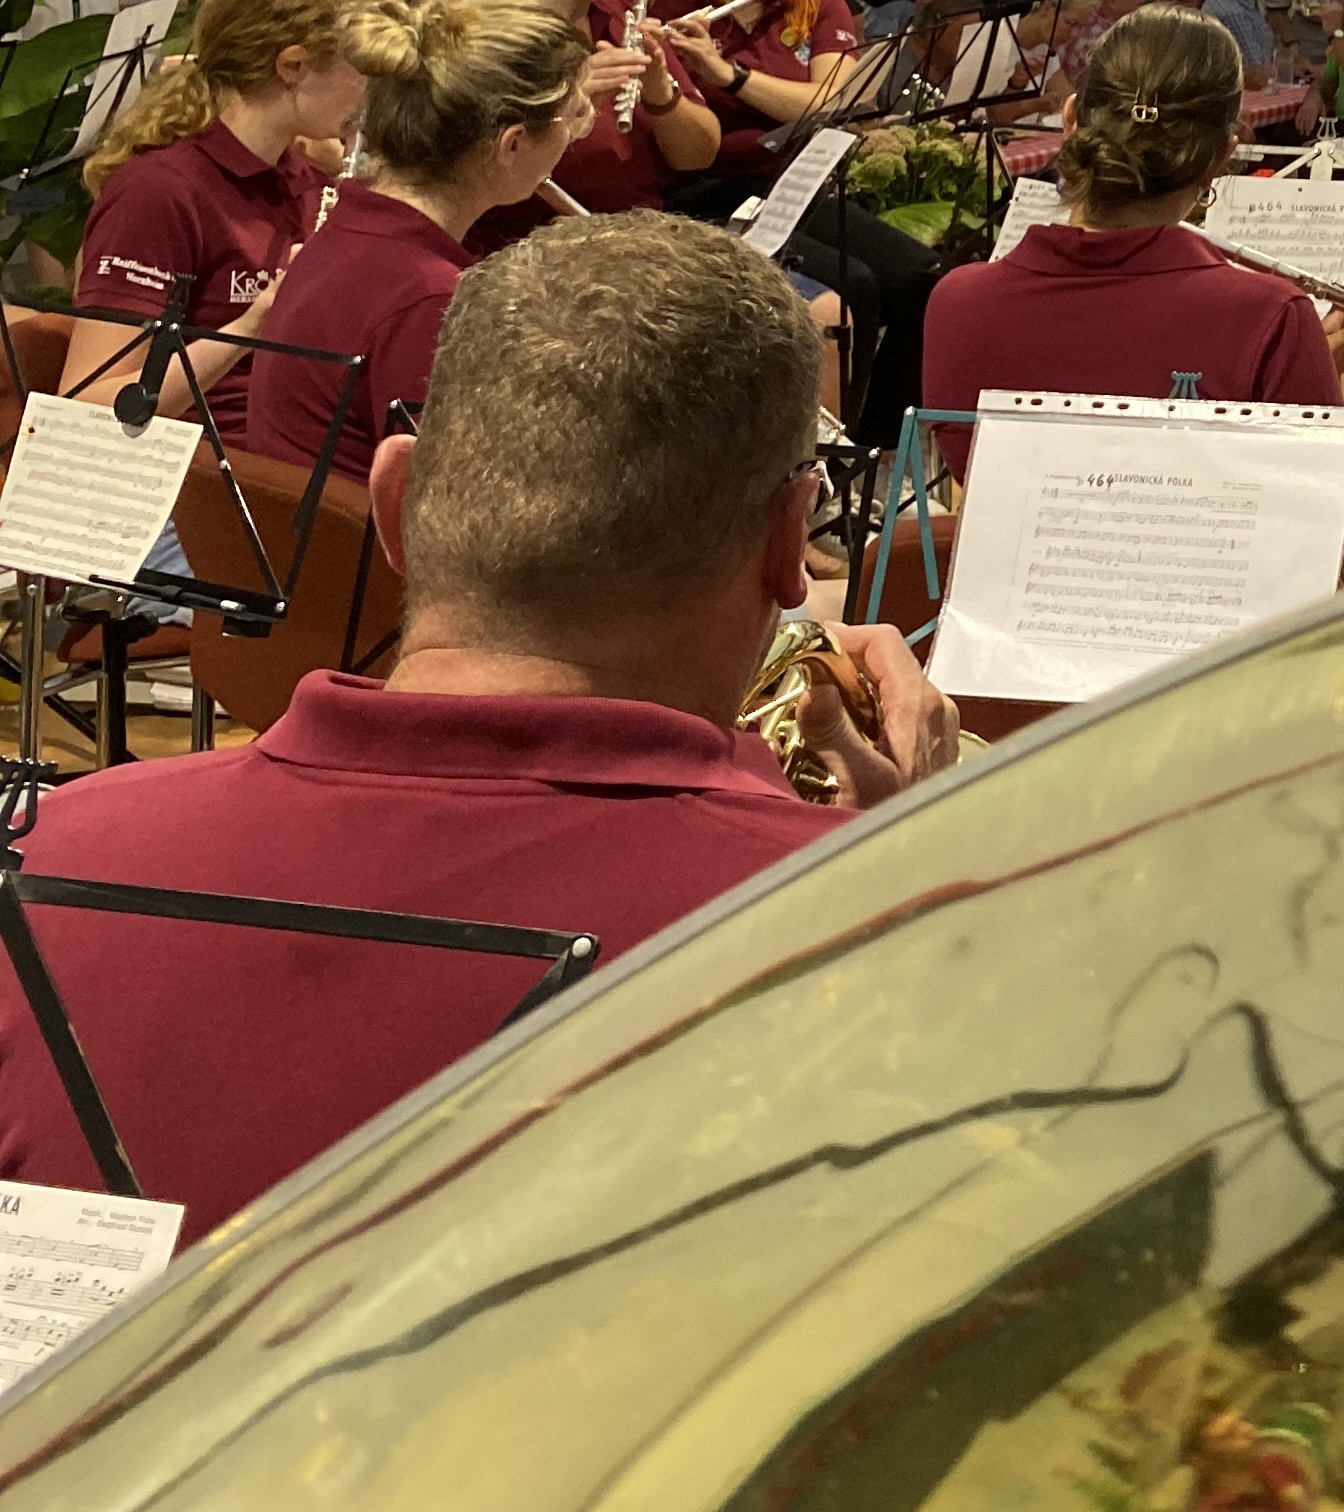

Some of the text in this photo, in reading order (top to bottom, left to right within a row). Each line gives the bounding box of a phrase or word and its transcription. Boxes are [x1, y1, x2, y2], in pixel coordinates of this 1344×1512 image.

[1087, 473, 1115, 491] 464
[1114, 472, 1194, 488] SLAVONICKÁ POLKA
